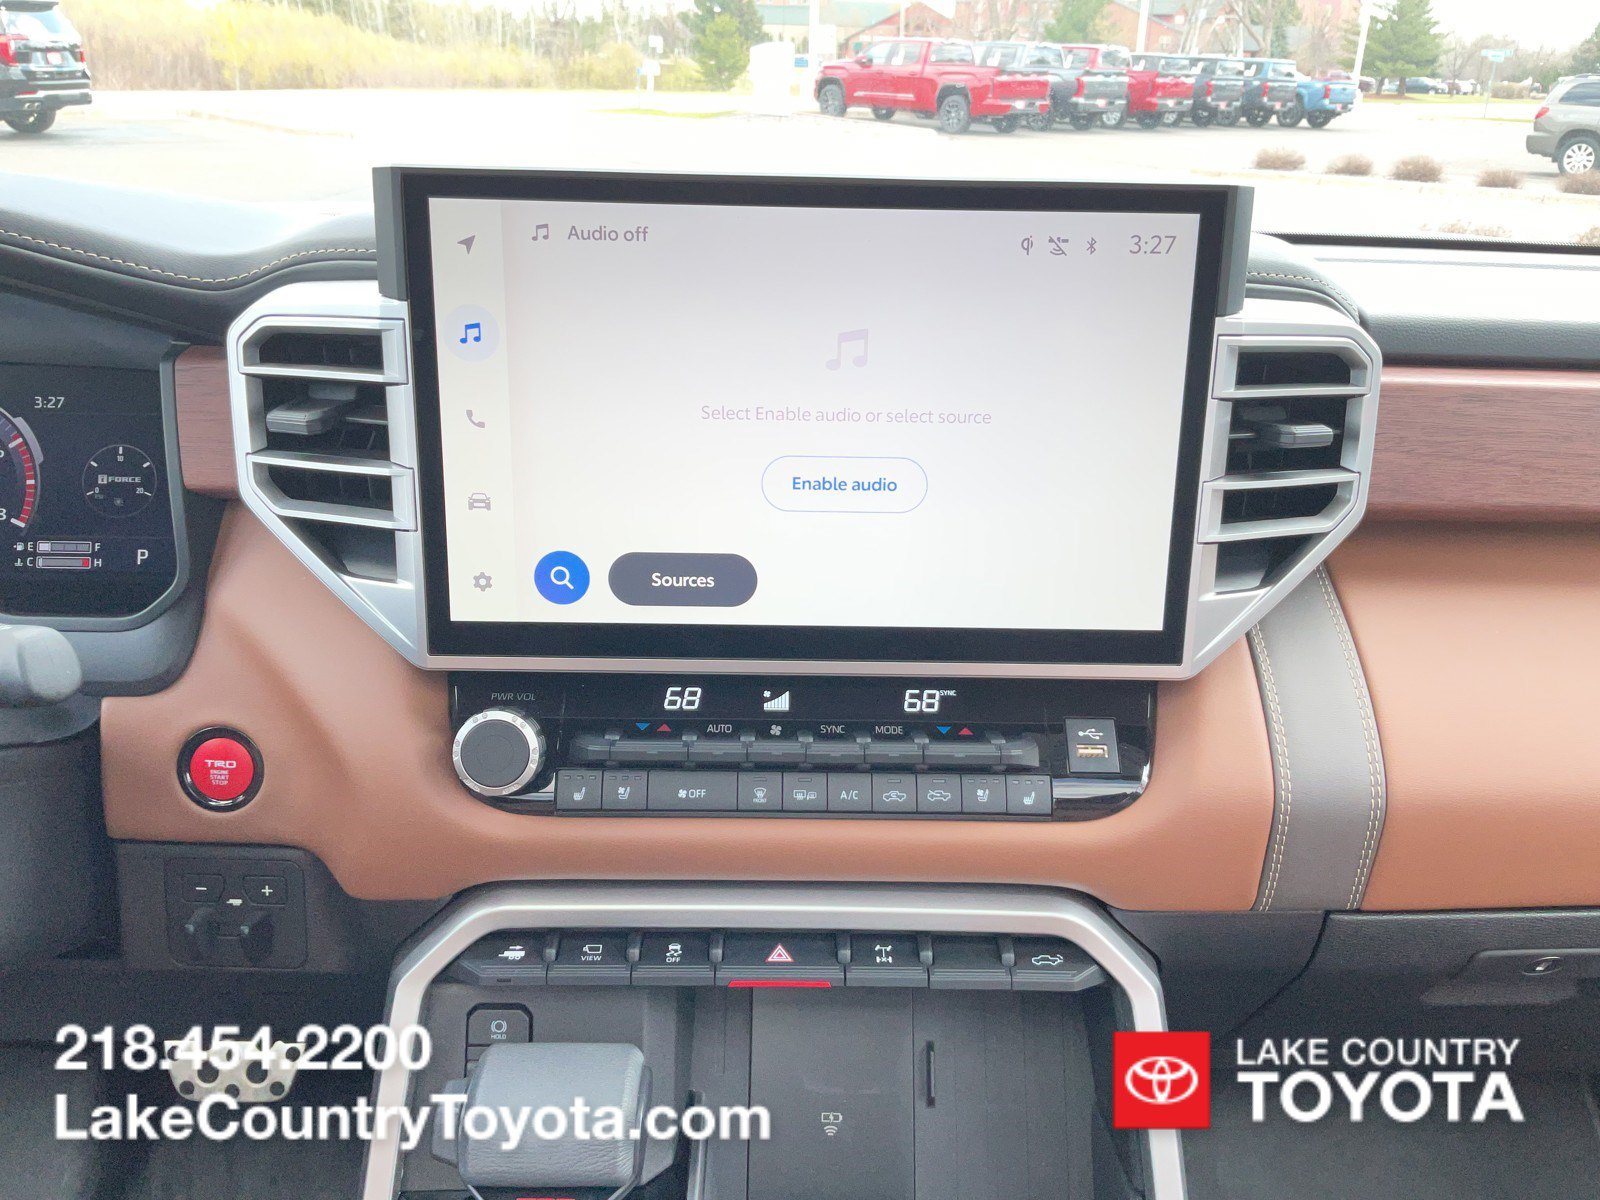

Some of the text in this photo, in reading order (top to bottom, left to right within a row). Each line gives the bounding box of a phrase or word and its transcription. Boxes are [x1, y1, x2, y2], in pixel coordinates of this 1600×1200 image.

[567, 225, 649, 242] Audio off
[1129, 234, 1177, 255] 3:27
[34, 396, 65, 409] 3:27
[701, 405, 992, 425] Select Enable audio or select source
[792, 476, 898, 492] Enable audio
[27, 542, 101, 552] E F
[137, 549, 149, 565] P
[27, 558, 102, 568] C H
[651, 572, 715, 588] Sources
[491, 692, 537, 702] PWR VOL
[664, 686, 702, 711] 68
[940, 689, 958, 697] SYNC
[904, 688, 940, 713] 68
[706, 723, 733, 734] AUTO
[820, 724, 846, 735] SYNC
[875, 725, 904, 735] MODE
[204, 759, 237, 769] TRD
[688, 788, 707, 799] OFF
[840, 789, 859, 801] A/C
[580, 954, 603, 962] VIEW
[665, 956, 682, 964] OFF
